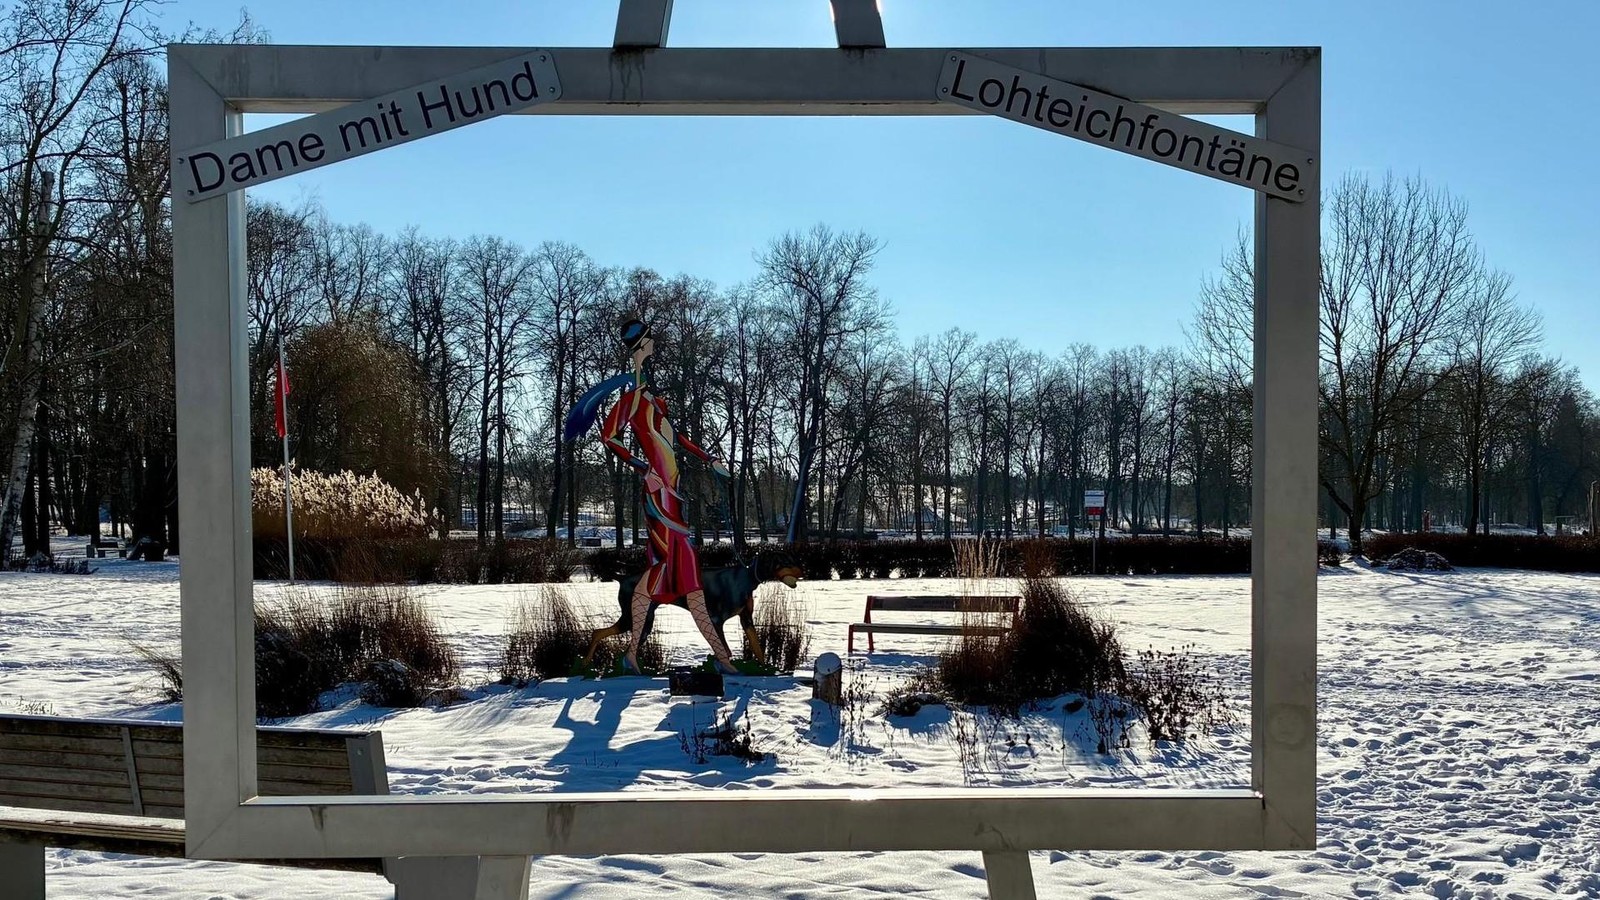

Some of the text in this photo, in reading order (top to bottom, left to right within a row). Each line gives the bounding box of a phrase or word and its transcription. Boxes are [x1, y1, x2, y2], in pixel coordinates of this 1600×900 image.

[189, 61, 540, 193] Dame mit Hund
[950, 60, 1300, 193] Lohteichfontäne
